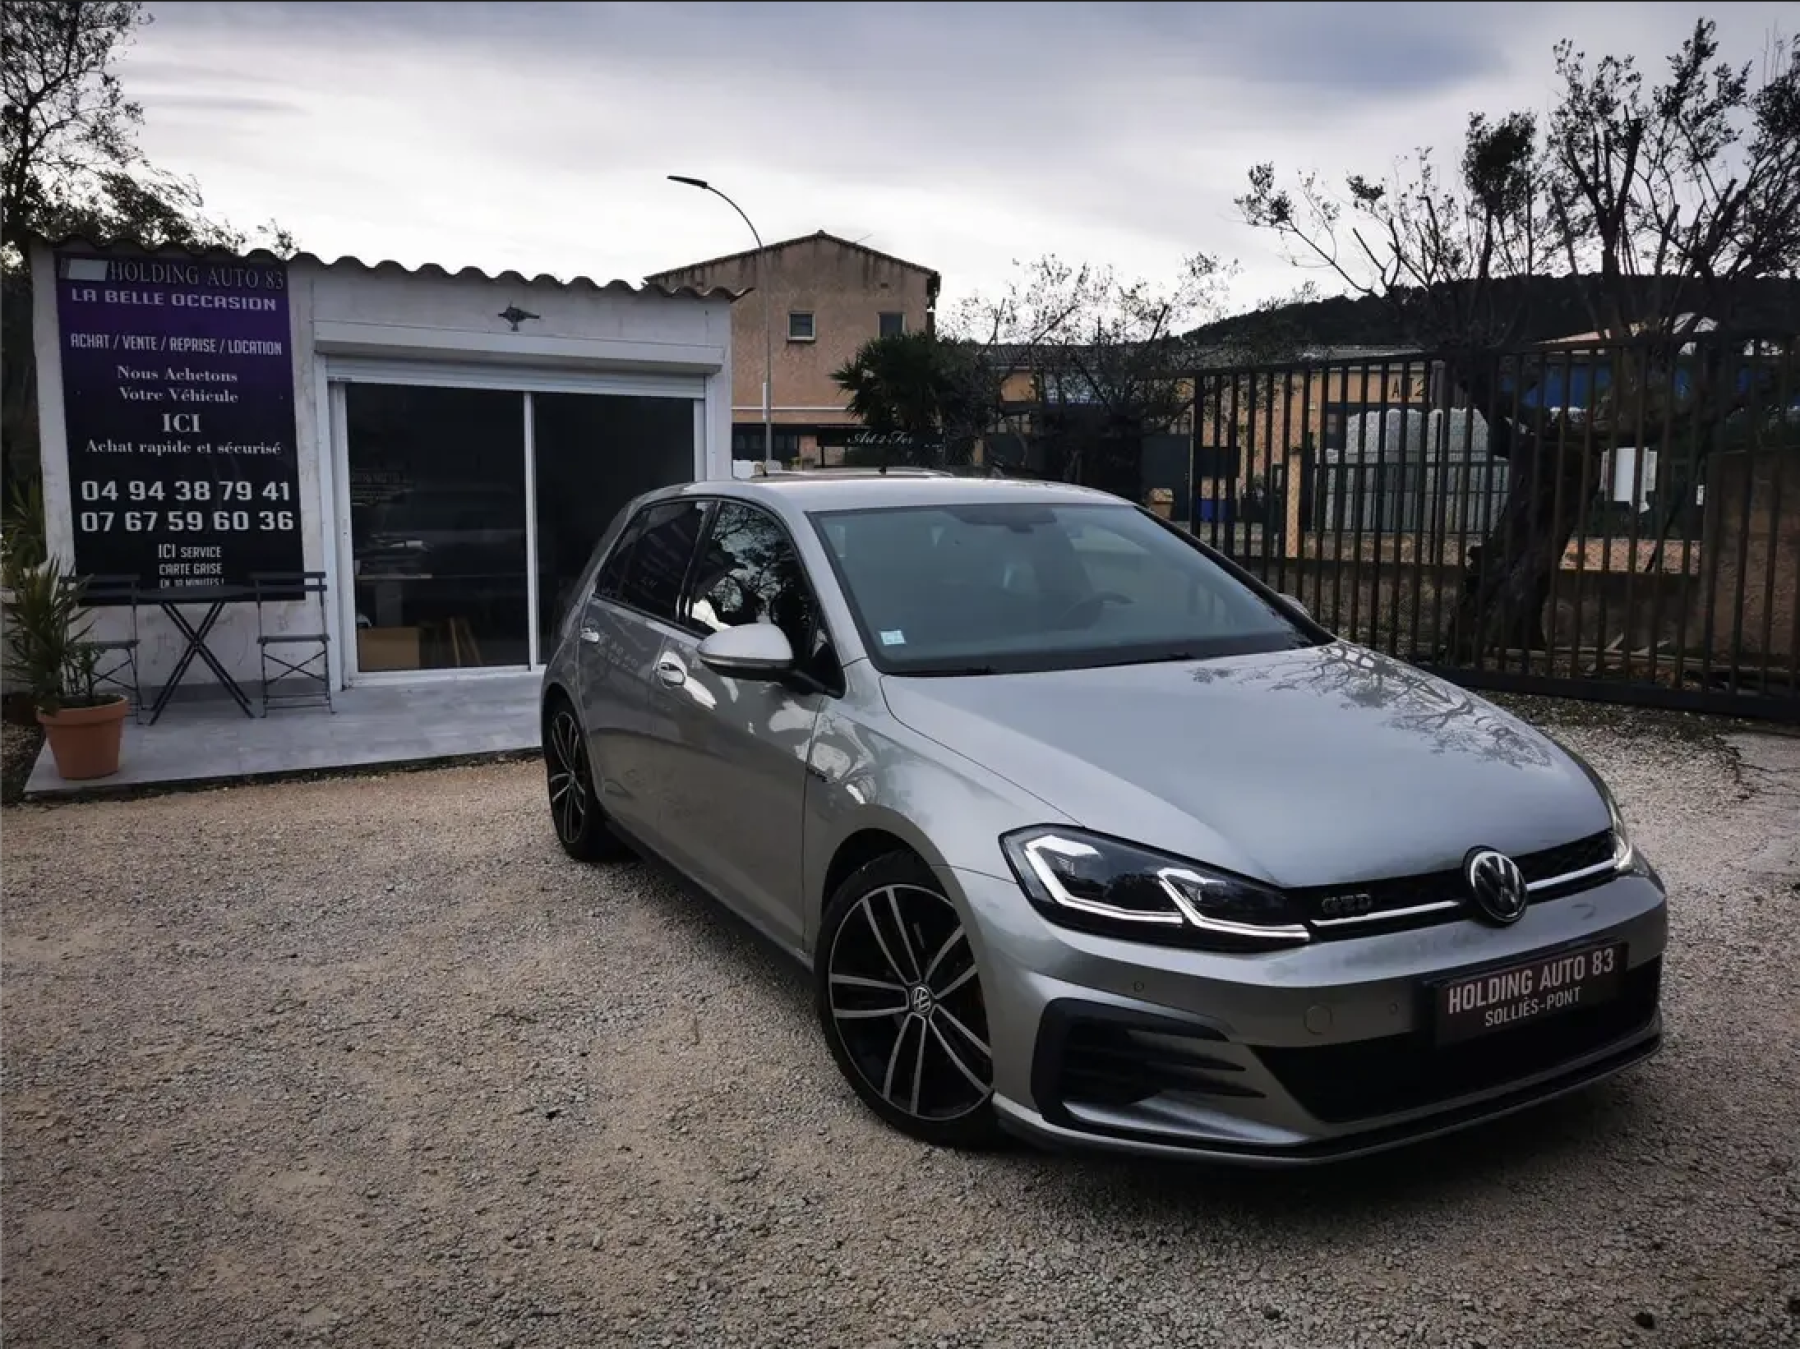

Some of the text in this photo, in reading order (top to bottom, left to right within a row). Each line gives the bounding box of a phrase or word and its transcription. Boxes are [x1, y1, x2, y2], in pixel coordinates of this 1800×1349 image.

[110, 261, 284, 290] HOLDING AUTO 83
[72, 288, 276, 311] LA BELLE OCCASION
[70, 333, 110, 350] ACHAT
[122, 336, 157, 351] VENTE
[169, 337, 216, 353] REPRISE
[228, 339, 282, 356] LOCATION
[117, 365, 238, 383] Nous Achetons
[119, 387, 239, 403] Votre Véhicule
[163, 413, 201, 433] ICI
[86, 439, 282, 457] Achat rapide et sécurisé
[81, 480, 290, 501] 04 94 38 79 41
[81, 510, 294, 532] 07 67 59 60 36
[158, 544, 222, 559] ICI SERVICE
[159, 563, 223, 575] CARTE GRISE
[1449, 948, 1614, 1014] HOLDING AUTO 83
[1485, 986, 1581, 1027] SOLLIÈS-PONT
